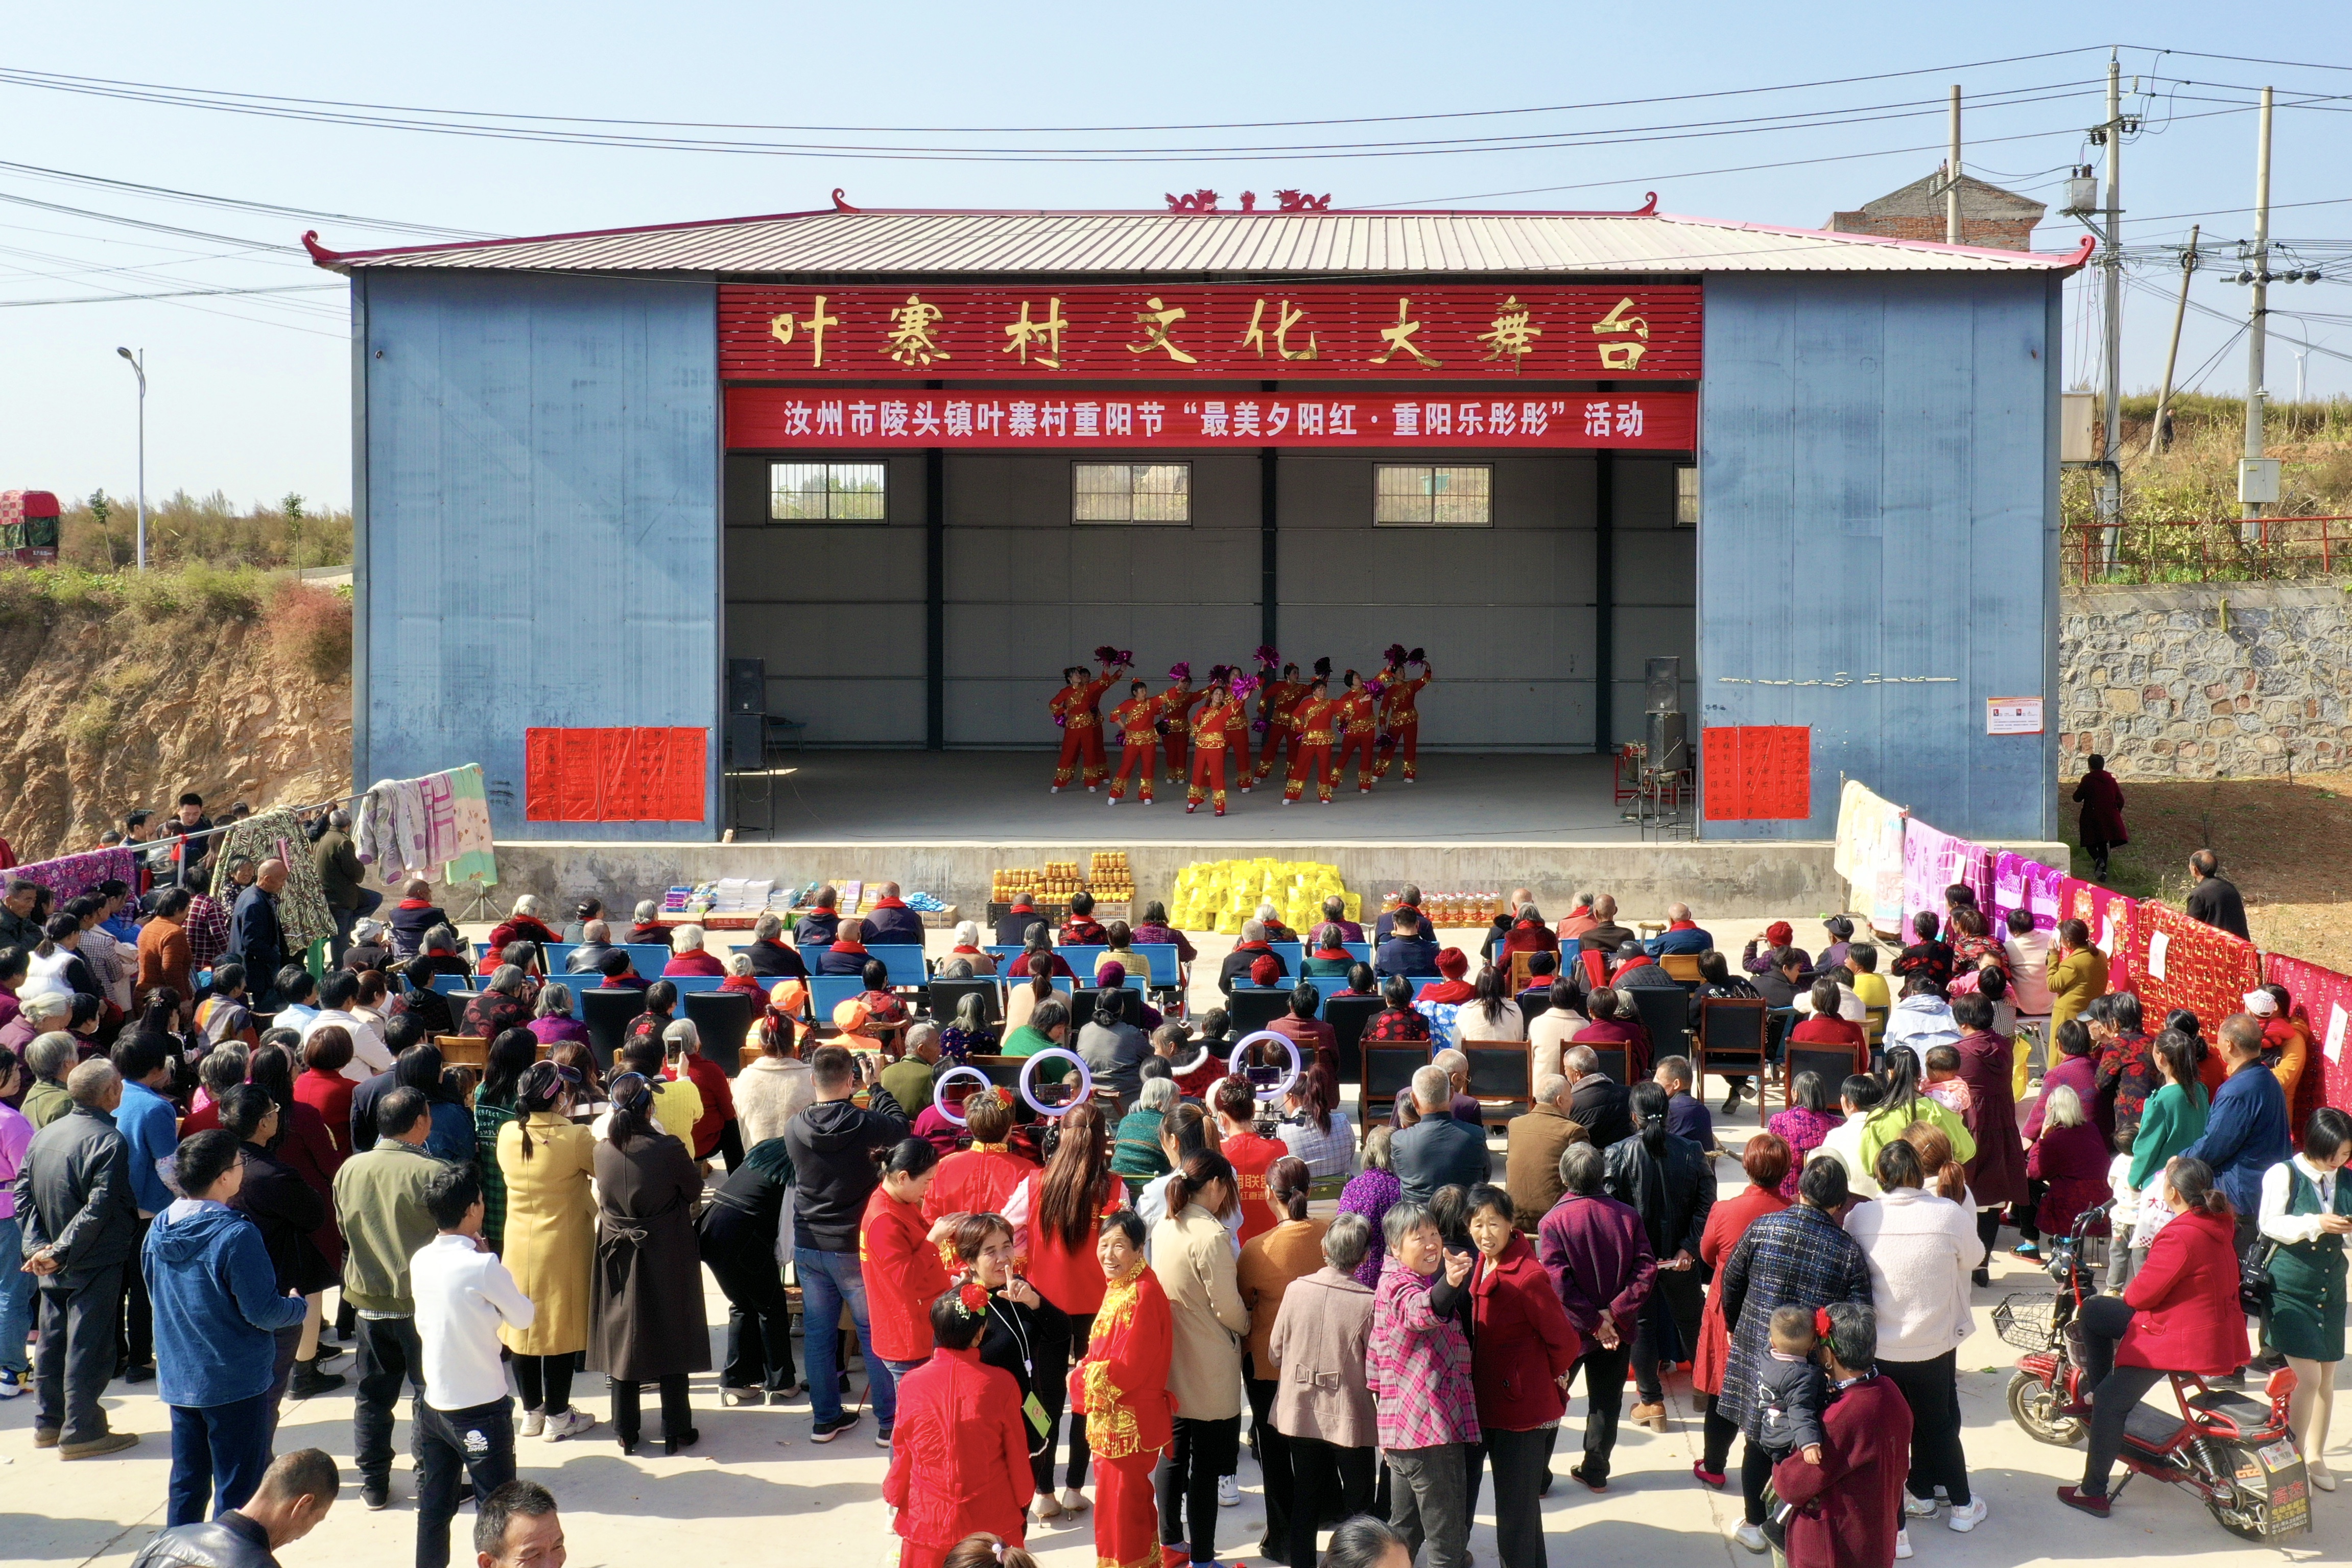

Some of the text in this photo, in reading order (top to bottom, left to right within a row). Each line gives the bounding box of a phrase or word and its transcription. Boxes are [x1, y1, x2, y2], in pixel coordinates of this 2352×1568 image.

[771, 294, 1649, 375] 叶寨村文化大舞台
[2271, 1480, 2306, 1507] 高杰
